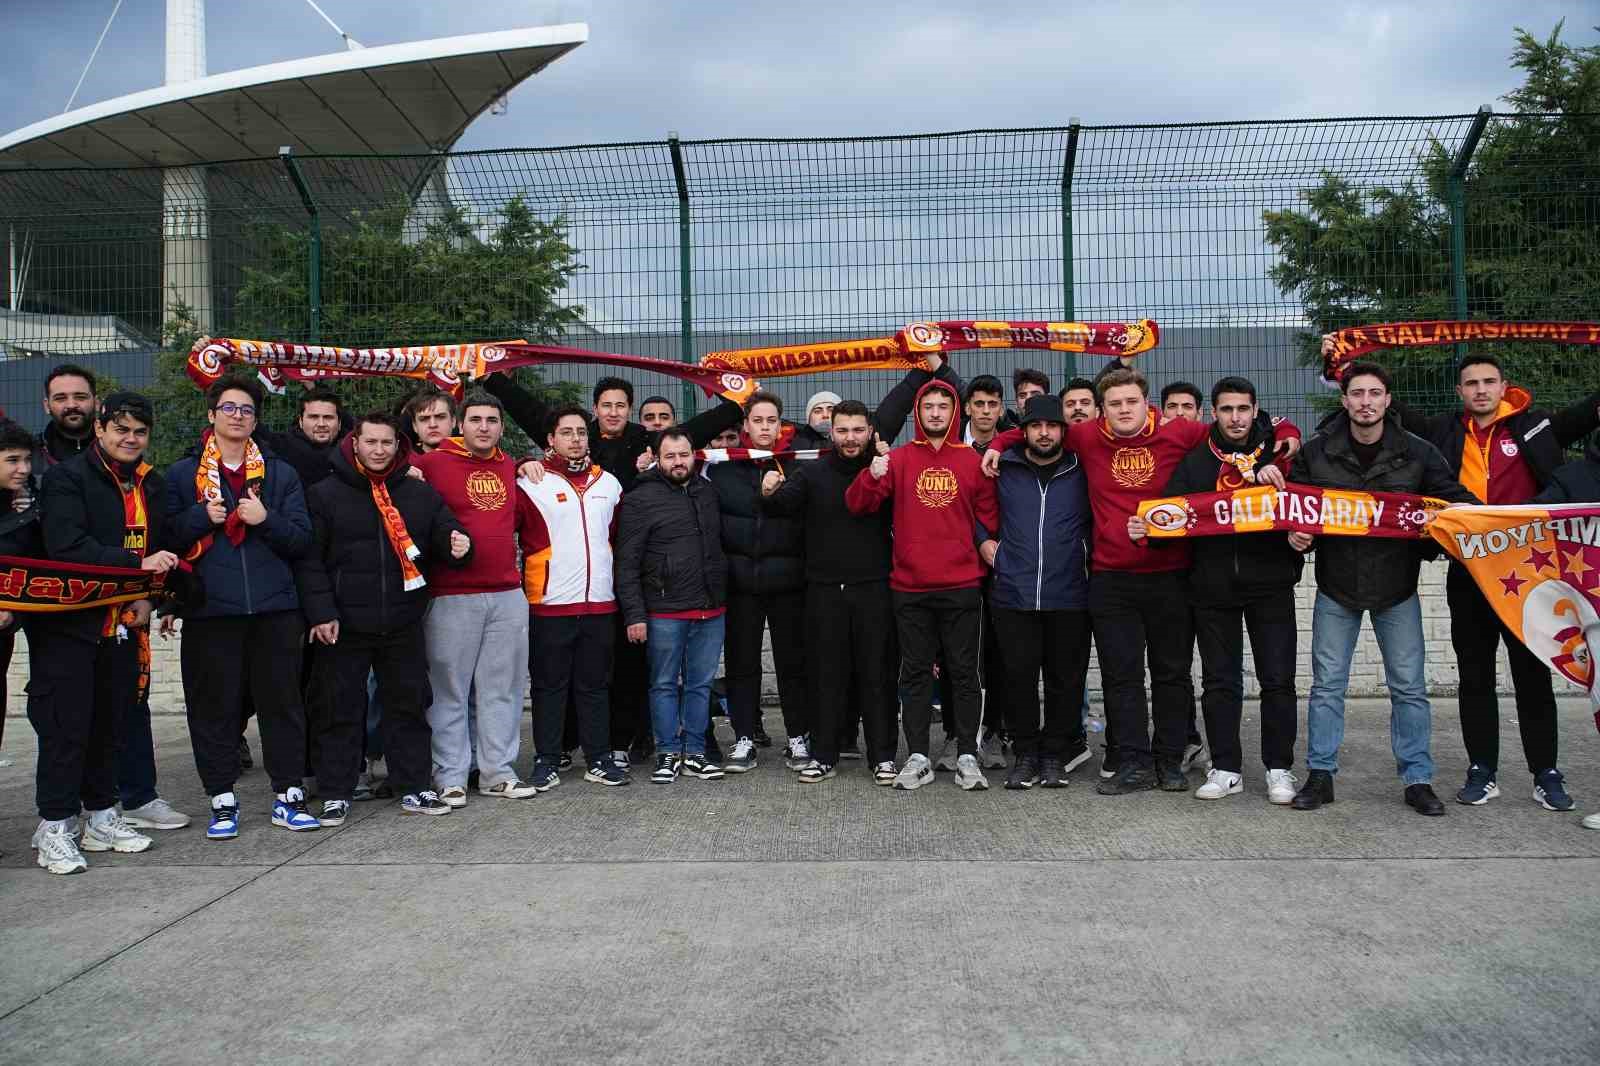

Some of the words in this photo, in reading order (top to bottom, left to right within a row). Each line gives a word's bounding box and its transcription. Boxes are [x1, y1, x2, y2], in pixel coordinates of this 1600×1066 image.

[962, 326, 1097, 346] GALATASARAY
[239, 341, 424, 372] GALATASARAY
[1119, 454, 1146, 470] UNI
[925, 476, 950, 491] UNI
[1213, 490, 1385, 527] GALATASARAY
